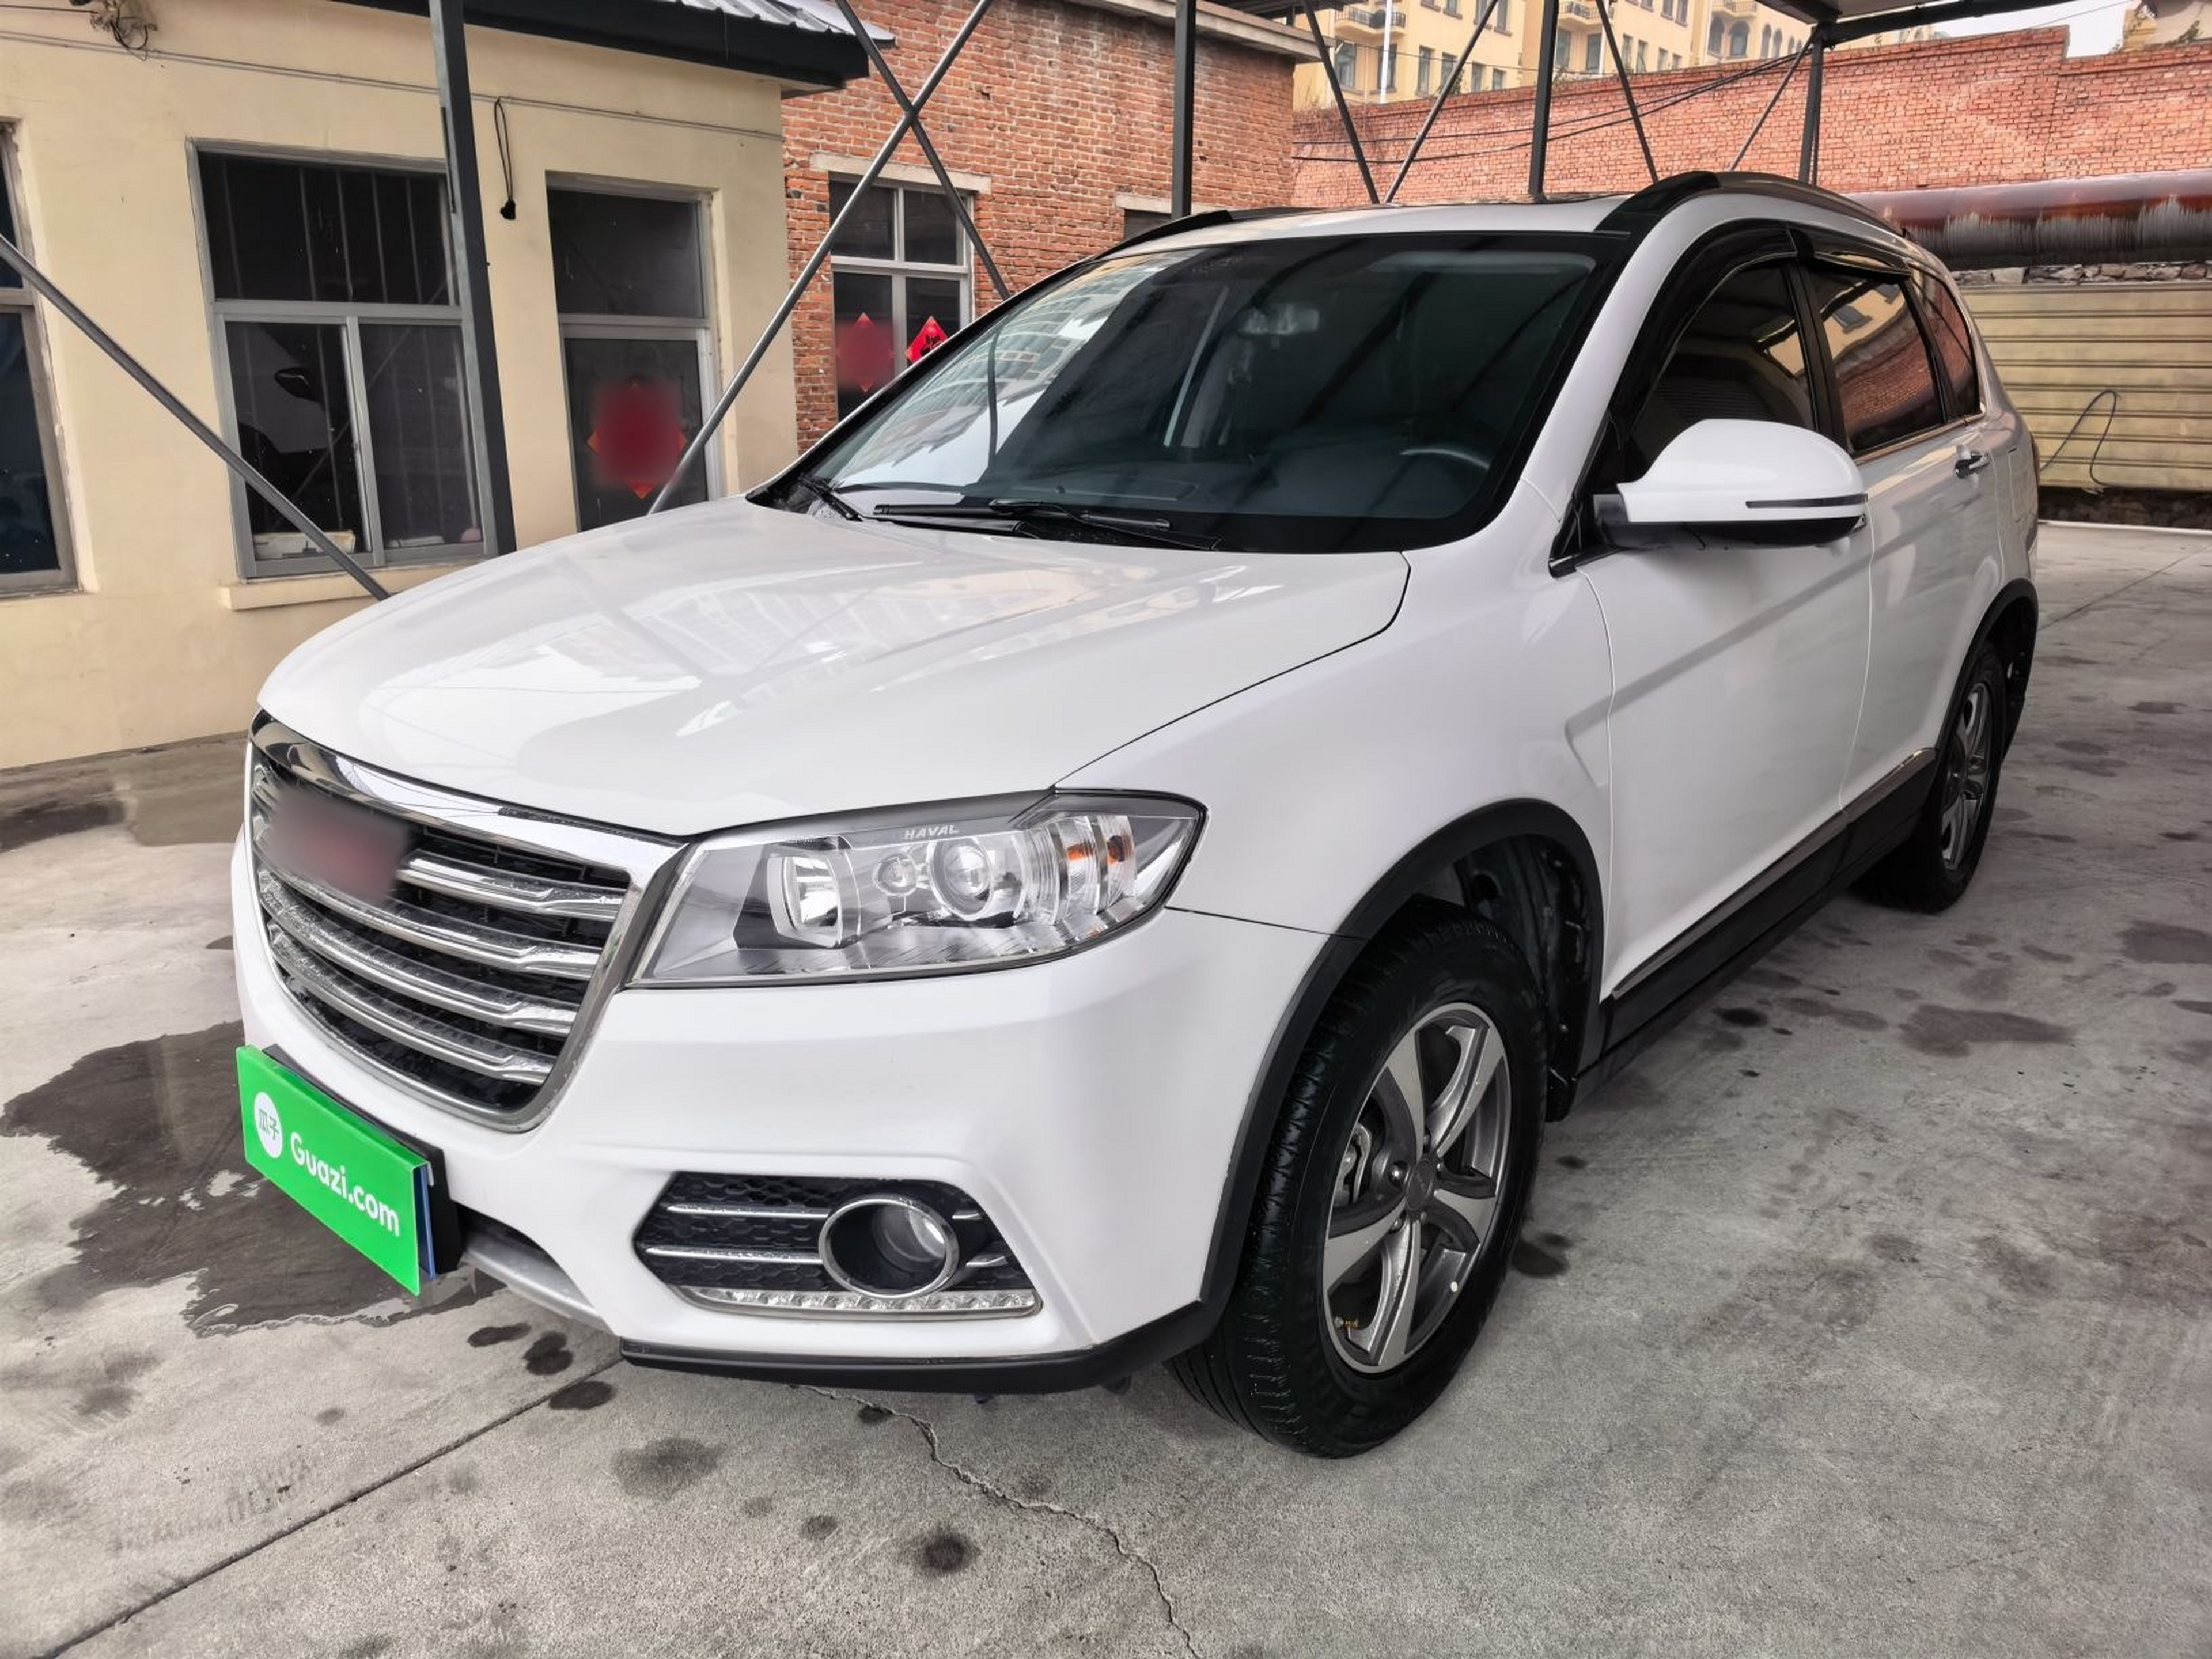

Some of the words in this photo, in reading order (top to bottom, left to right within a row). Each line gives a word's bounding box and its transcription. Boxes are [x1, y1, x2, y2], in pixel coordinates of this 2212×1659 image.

[903, 825, 960, 840] HAVAL
[258, 1107, 280, 1141] 瓜子
[290, 1132, 400, 1237] Guazi.com
